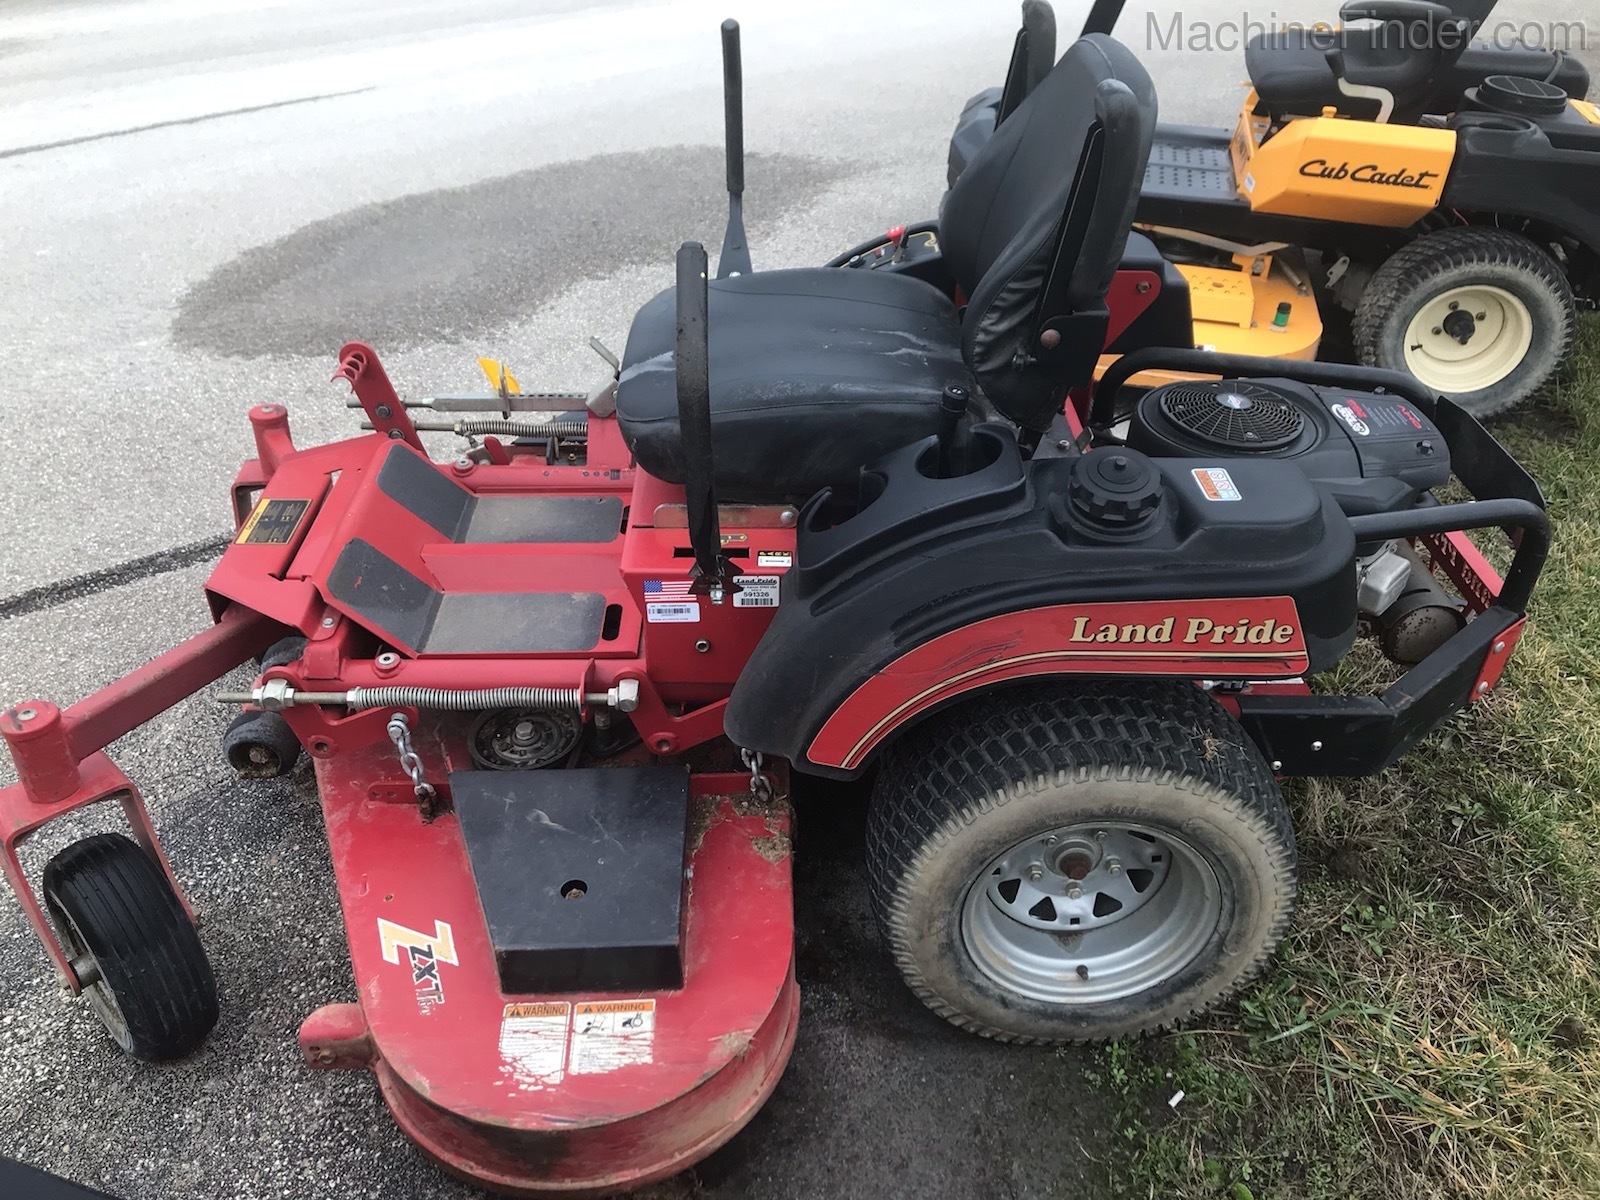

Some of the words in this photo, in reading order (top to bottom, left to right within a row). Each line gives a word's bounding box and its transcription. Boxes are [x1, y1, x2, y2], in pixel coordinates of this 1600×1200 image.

[1299, 159, 1349, 180] Cub
[1350, 164, 1439, 189] Cadet
[1069, 616, 1176, 644] Land
[1183, 617, 1294, 645] Pride
[522, 1004, 565, 1016] WARNING
[595, 1003, 645, 1013] WARNING
